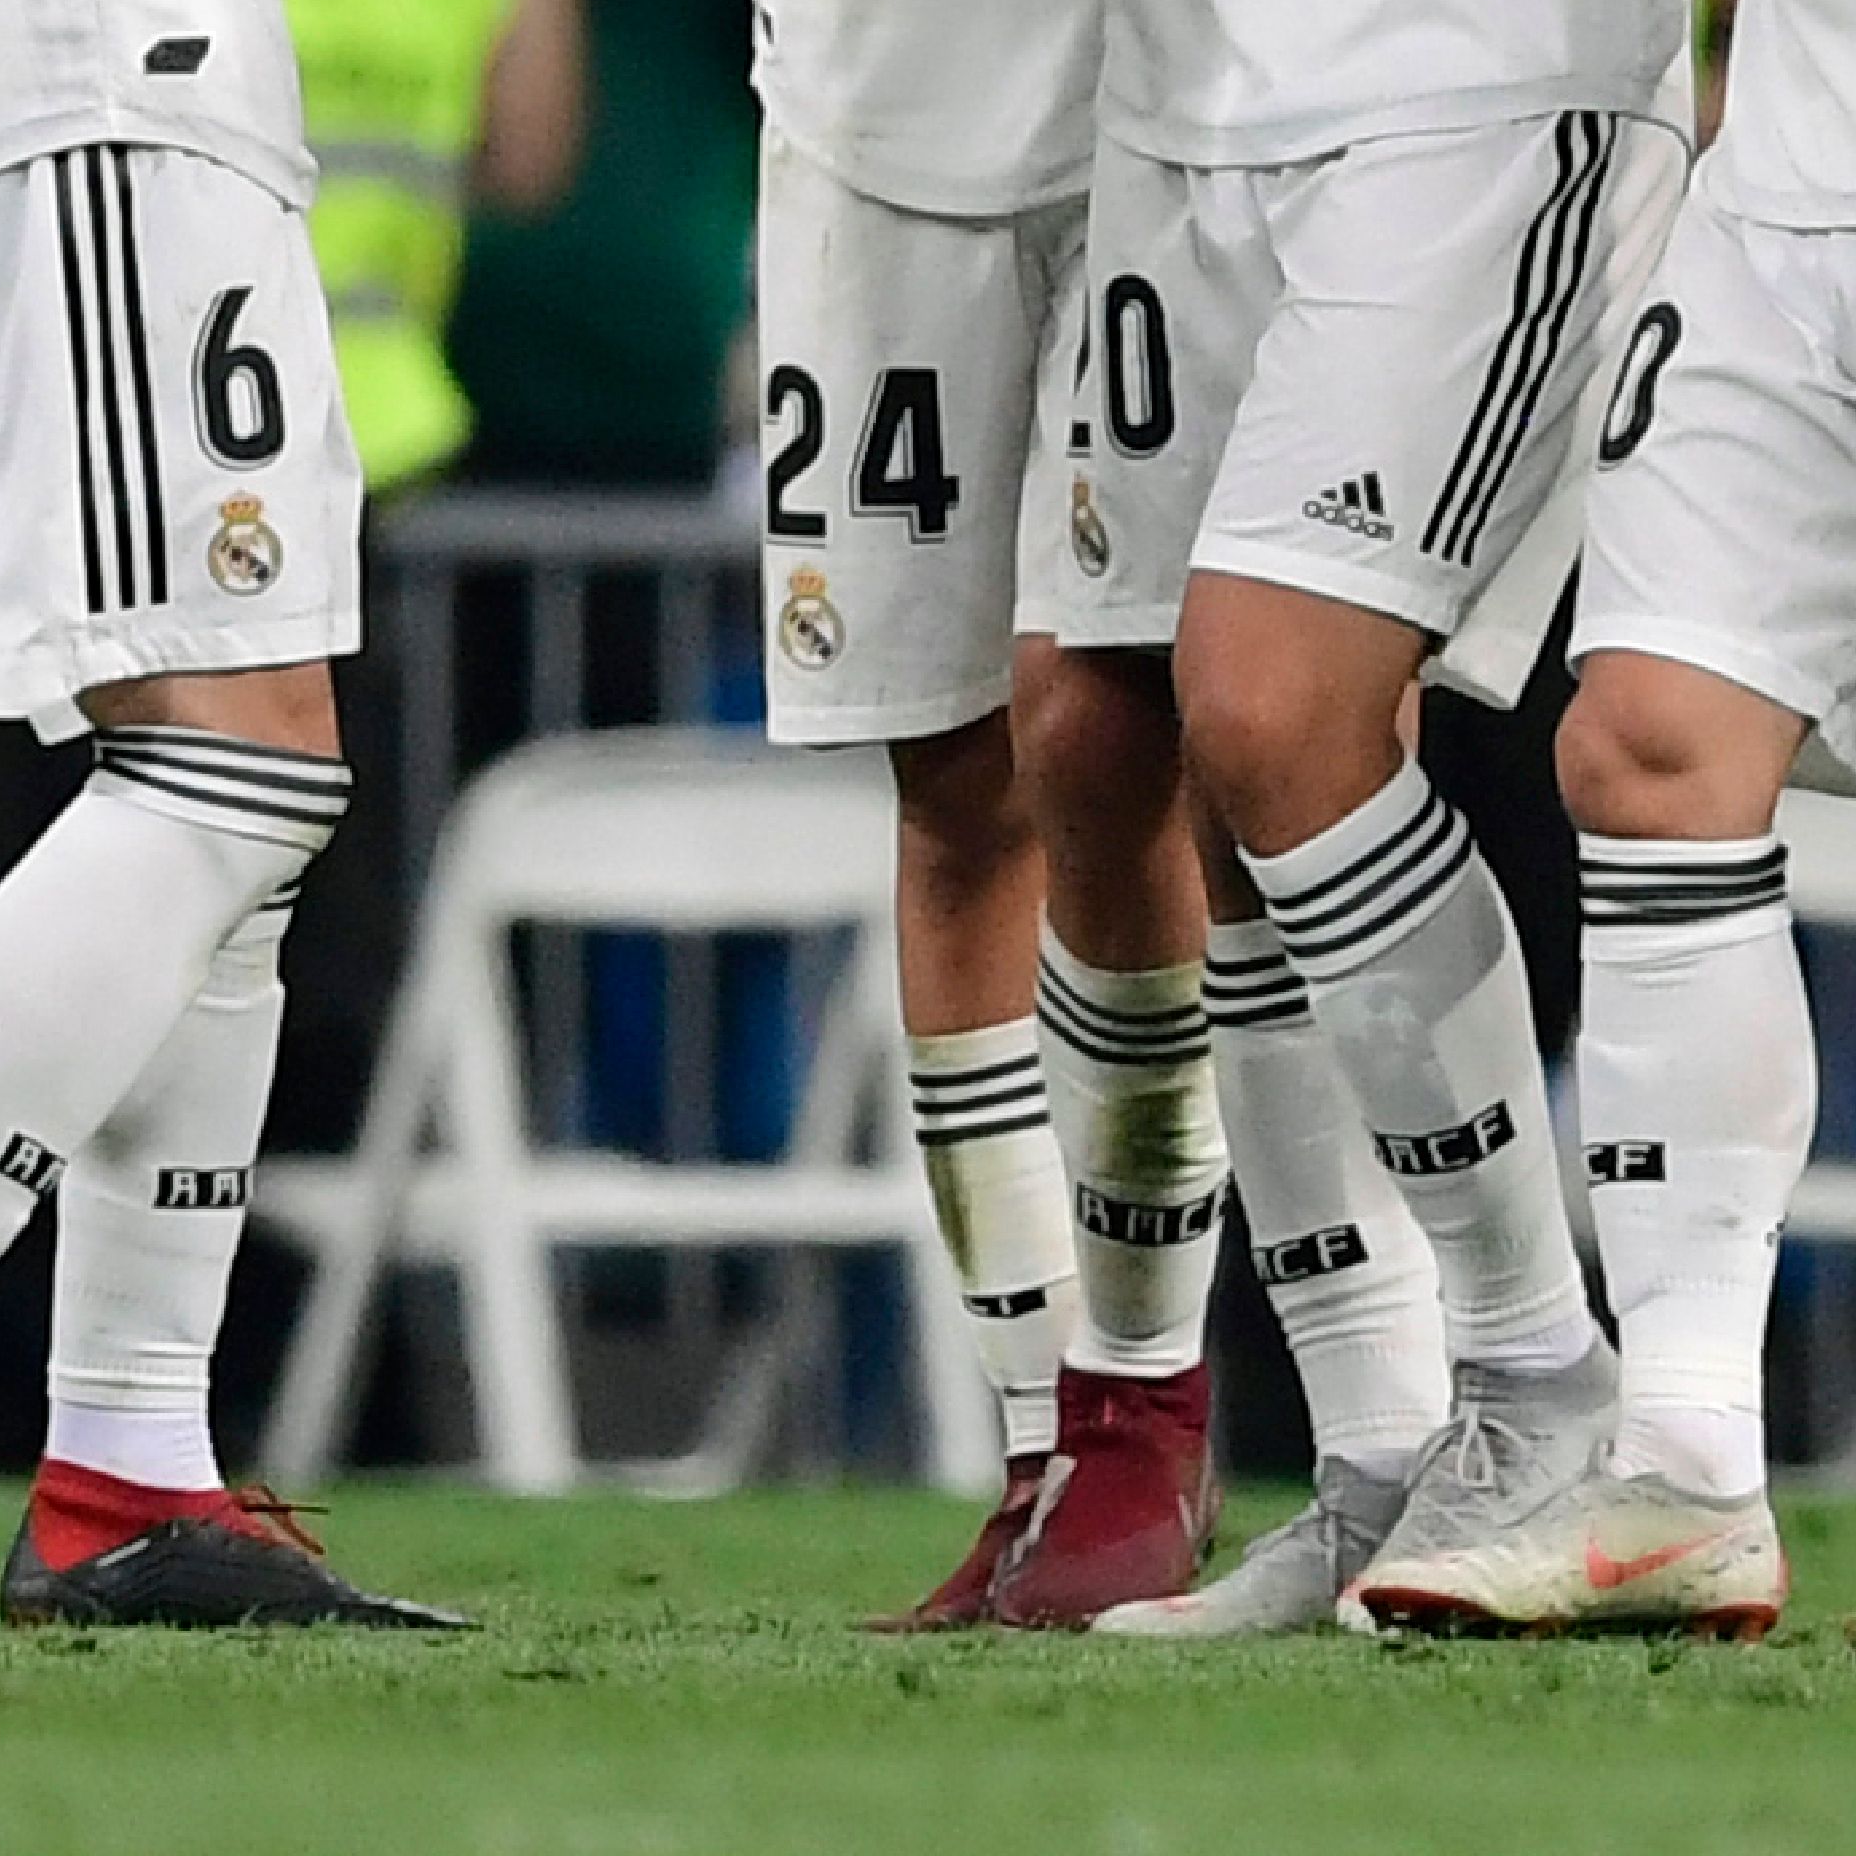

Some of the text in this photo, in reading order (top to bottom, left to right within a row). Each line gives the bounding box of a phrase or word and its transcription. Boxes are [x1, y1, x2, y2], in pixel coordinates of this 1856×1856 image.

[194, 284, 287, 472] 6
[766, 363, 961, 546] 24
[1301, 500, 1395, 542] adidas
